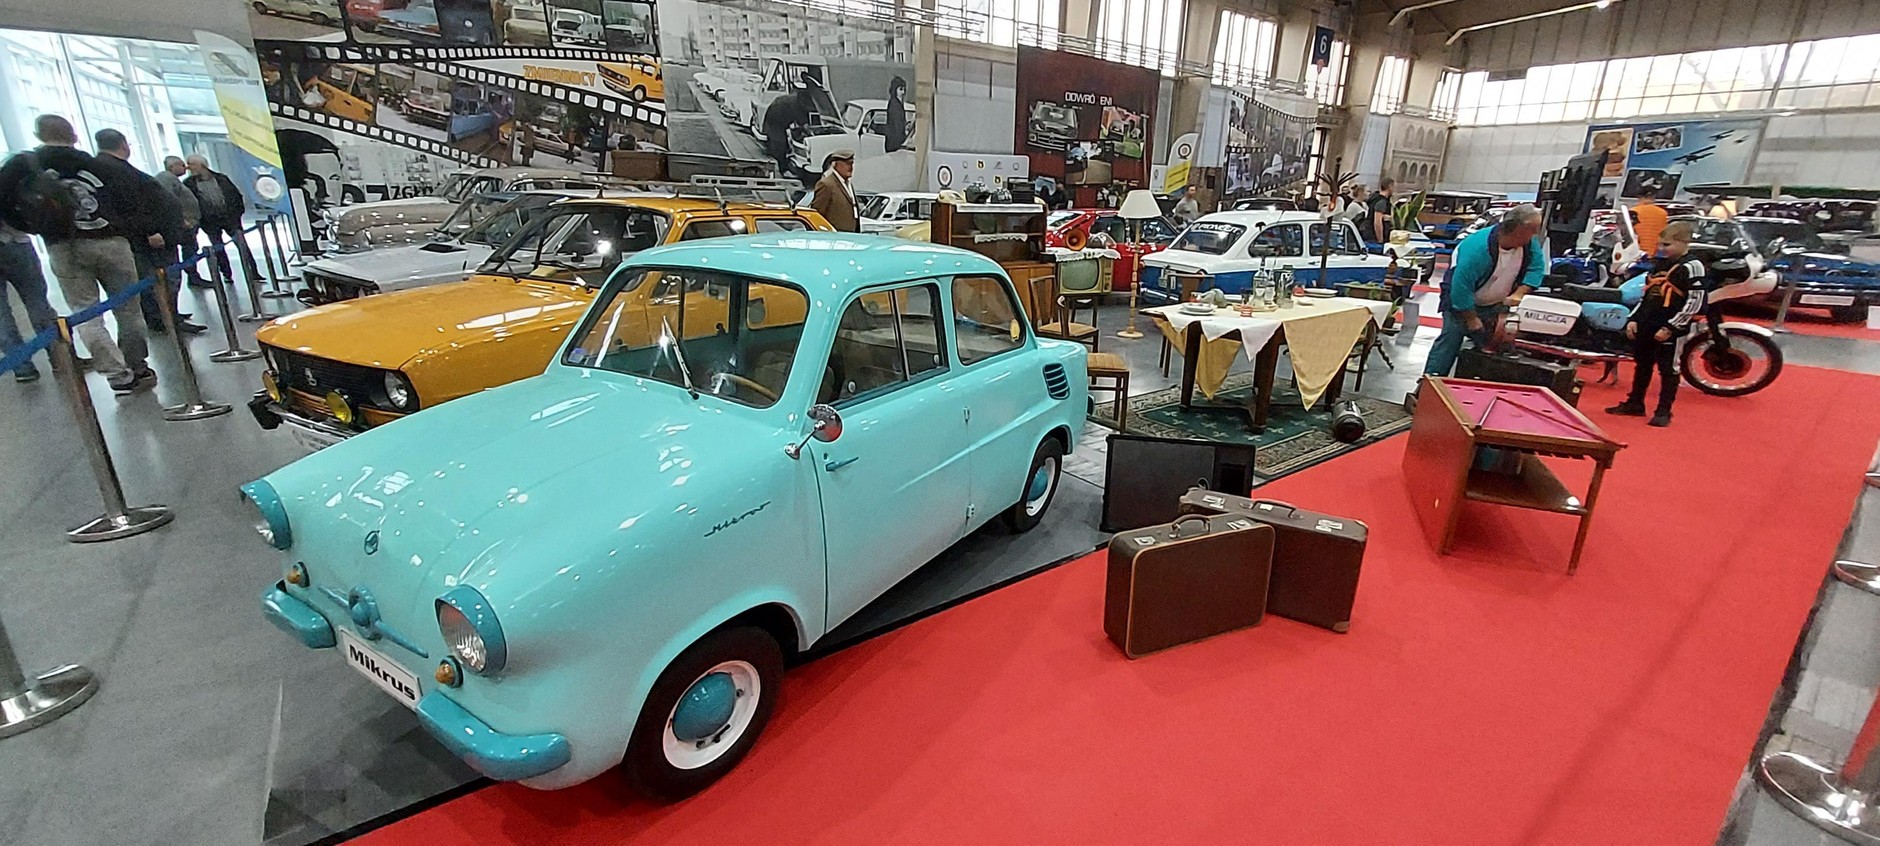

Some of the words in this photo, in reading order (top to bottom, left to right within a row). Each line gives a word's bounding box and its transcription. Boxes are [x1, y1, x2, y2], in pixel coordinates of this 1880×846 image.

[1320, 35, 1328, 54] 6
[523, 64, 596, 87] ZMIENNICY
[1525, 311, 1567, 325] MILICJA
[349, 644, 416, 701] Mikrus
